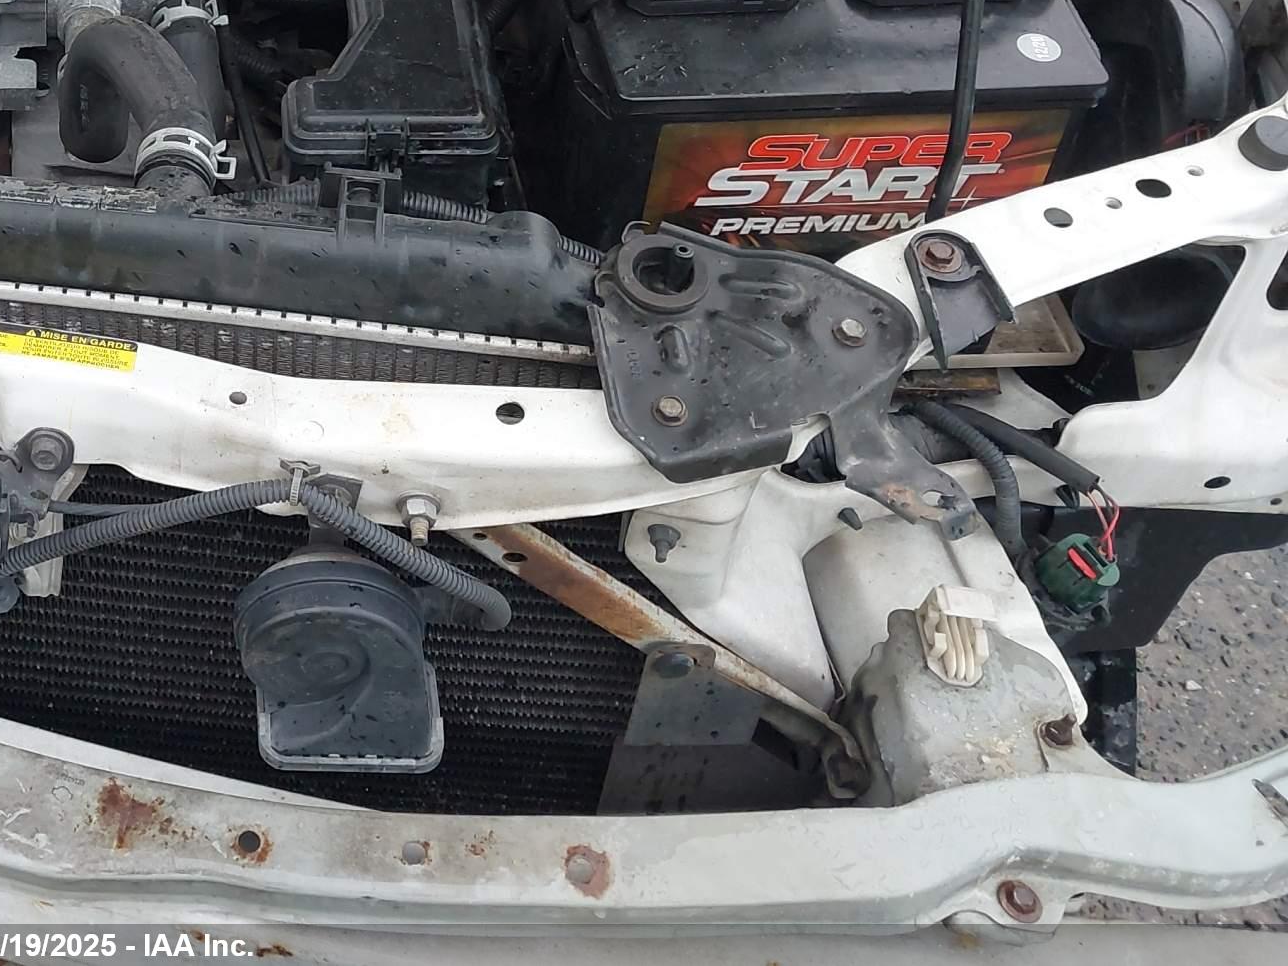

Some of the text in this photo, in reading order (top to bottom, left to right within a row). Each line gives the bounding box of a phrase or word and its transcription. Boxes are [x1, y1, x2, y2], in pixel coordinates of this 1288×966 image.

[738, 132, 1013, 170] SUPER
[694, 163, 1004, 207] START
[709, 212, 926, 236] PREMIUM
[40, 330, 131, 350] MISE EN GARDE
